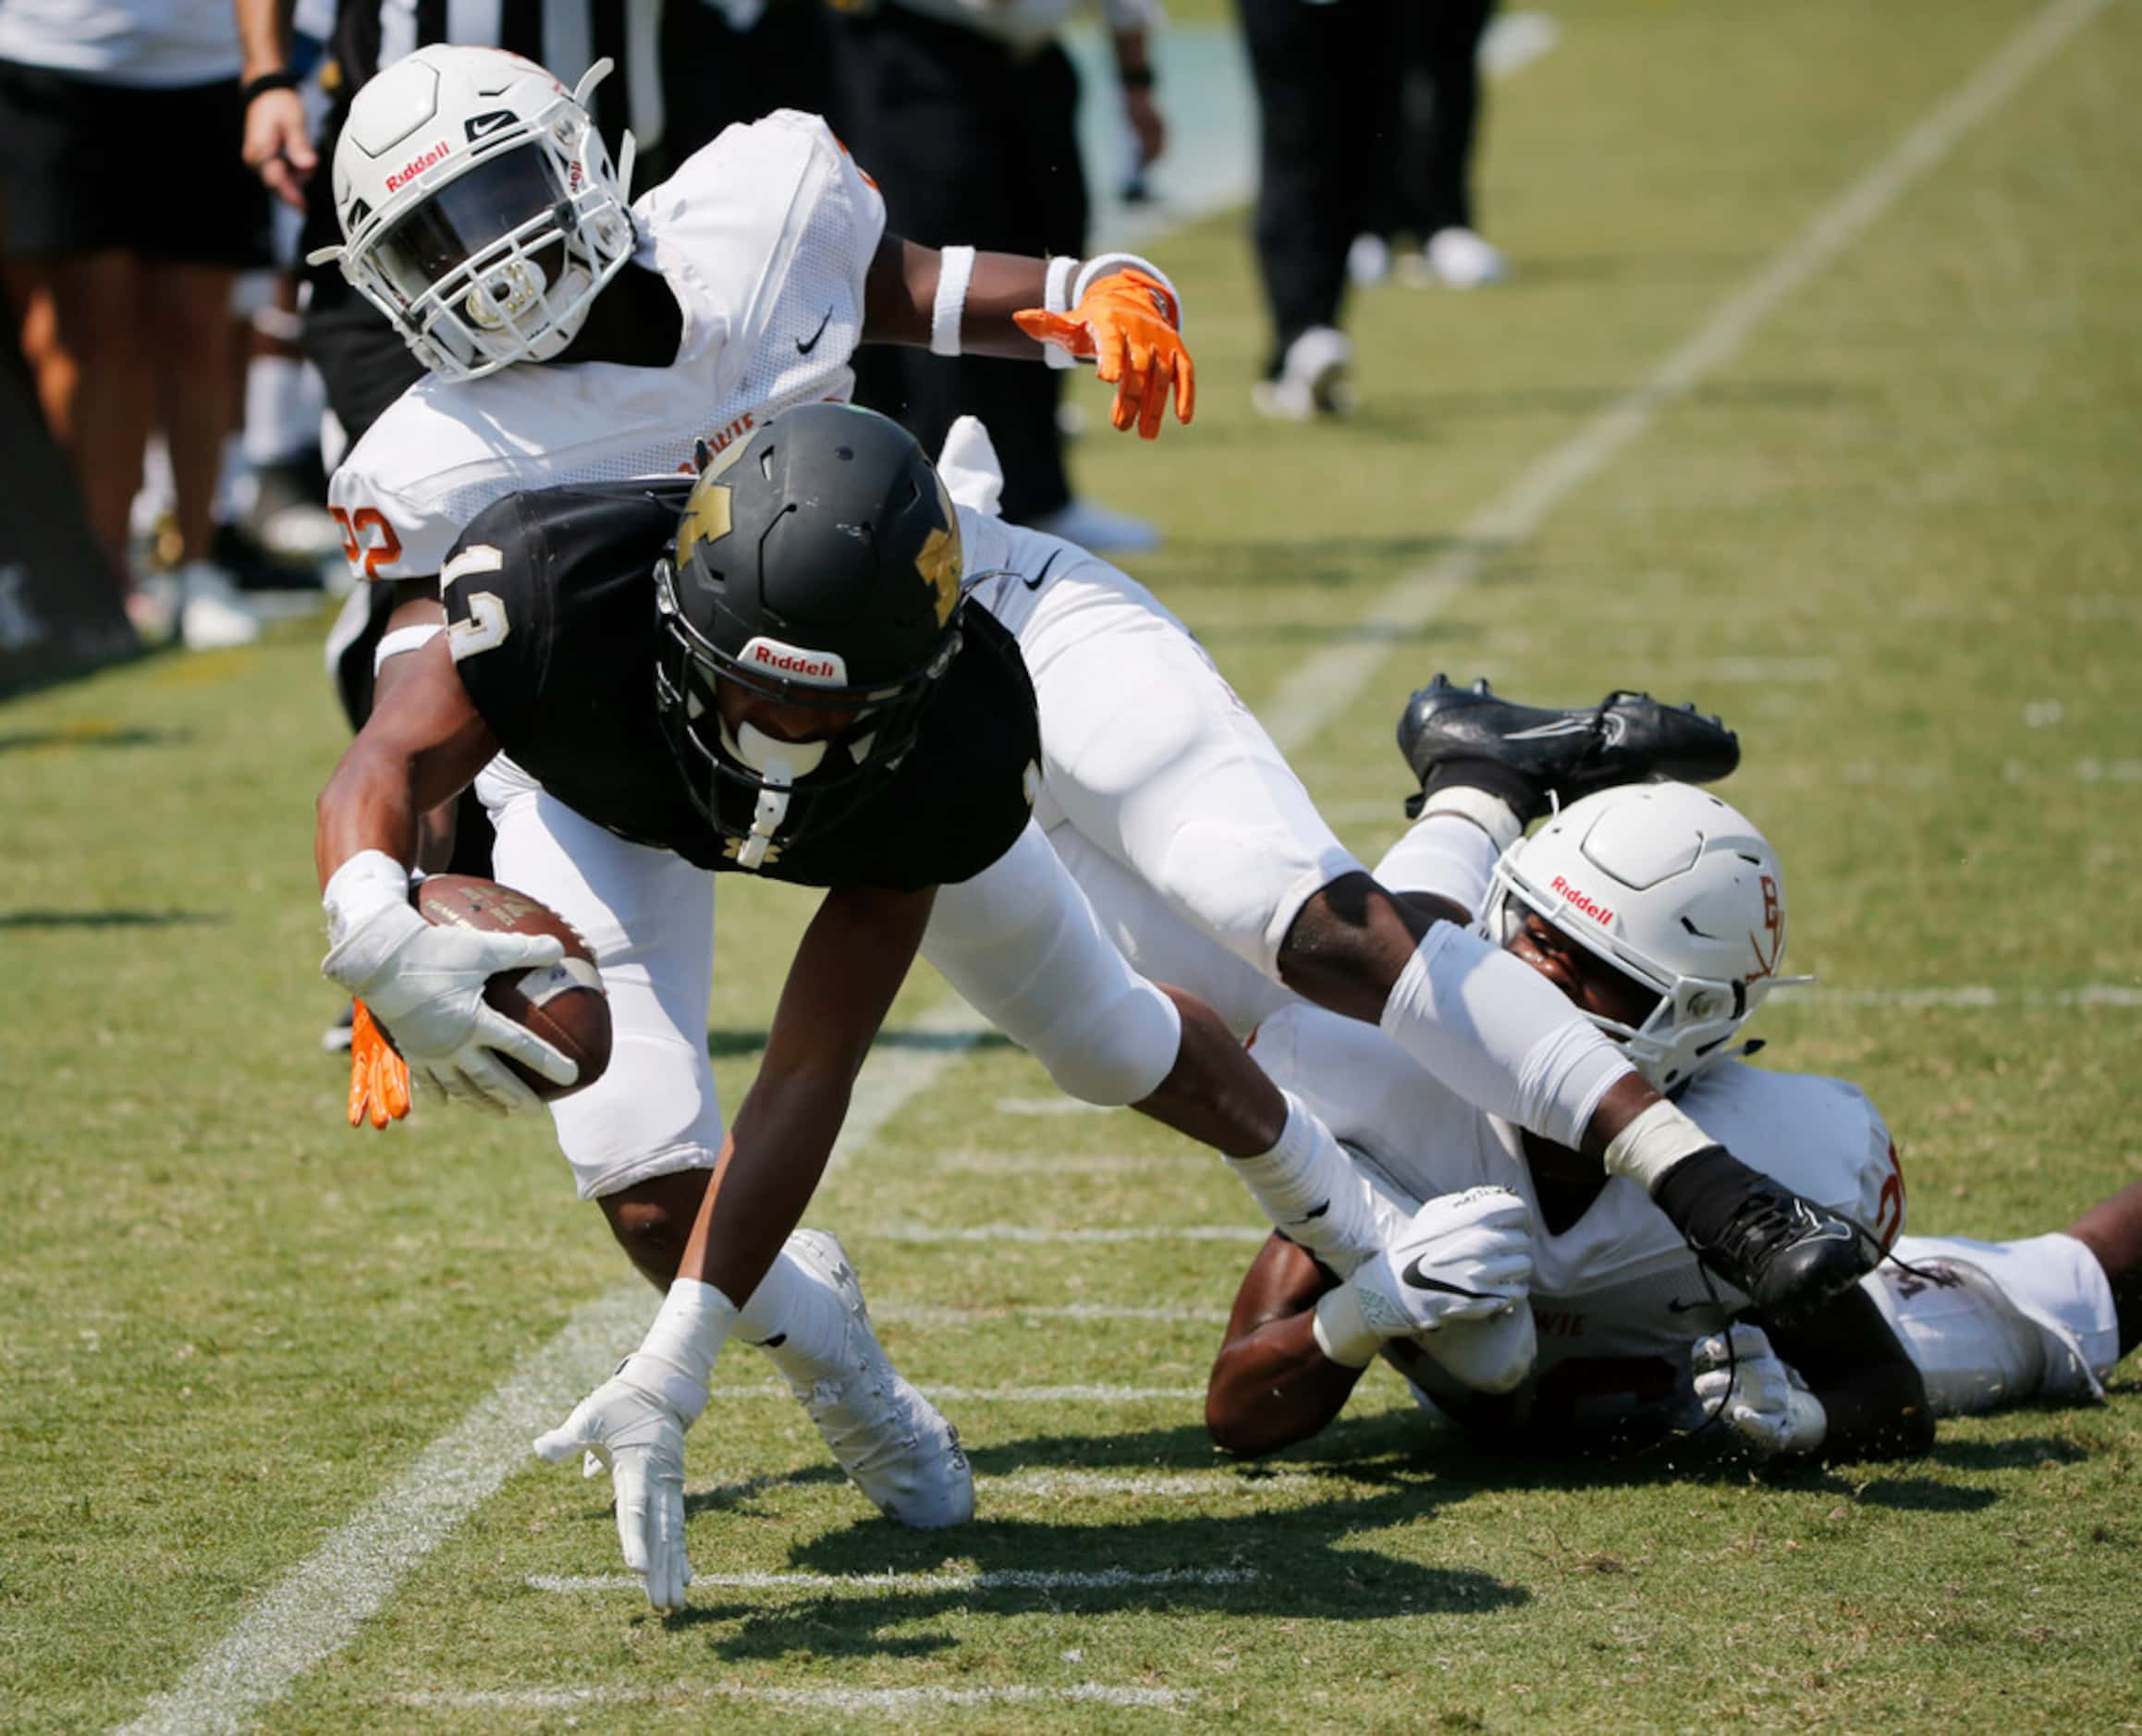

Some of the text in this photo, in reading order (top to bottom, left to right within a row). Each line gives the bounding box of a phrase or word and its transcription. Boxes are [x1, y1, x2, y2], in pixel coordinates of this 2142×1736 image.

[385, 140, 450, 192] Riddell
[754, 644, 835, 678] Riddell
[1550, 874, 1614, 927] Riddell
[1533, 1310, 1585, 1337] WIE
